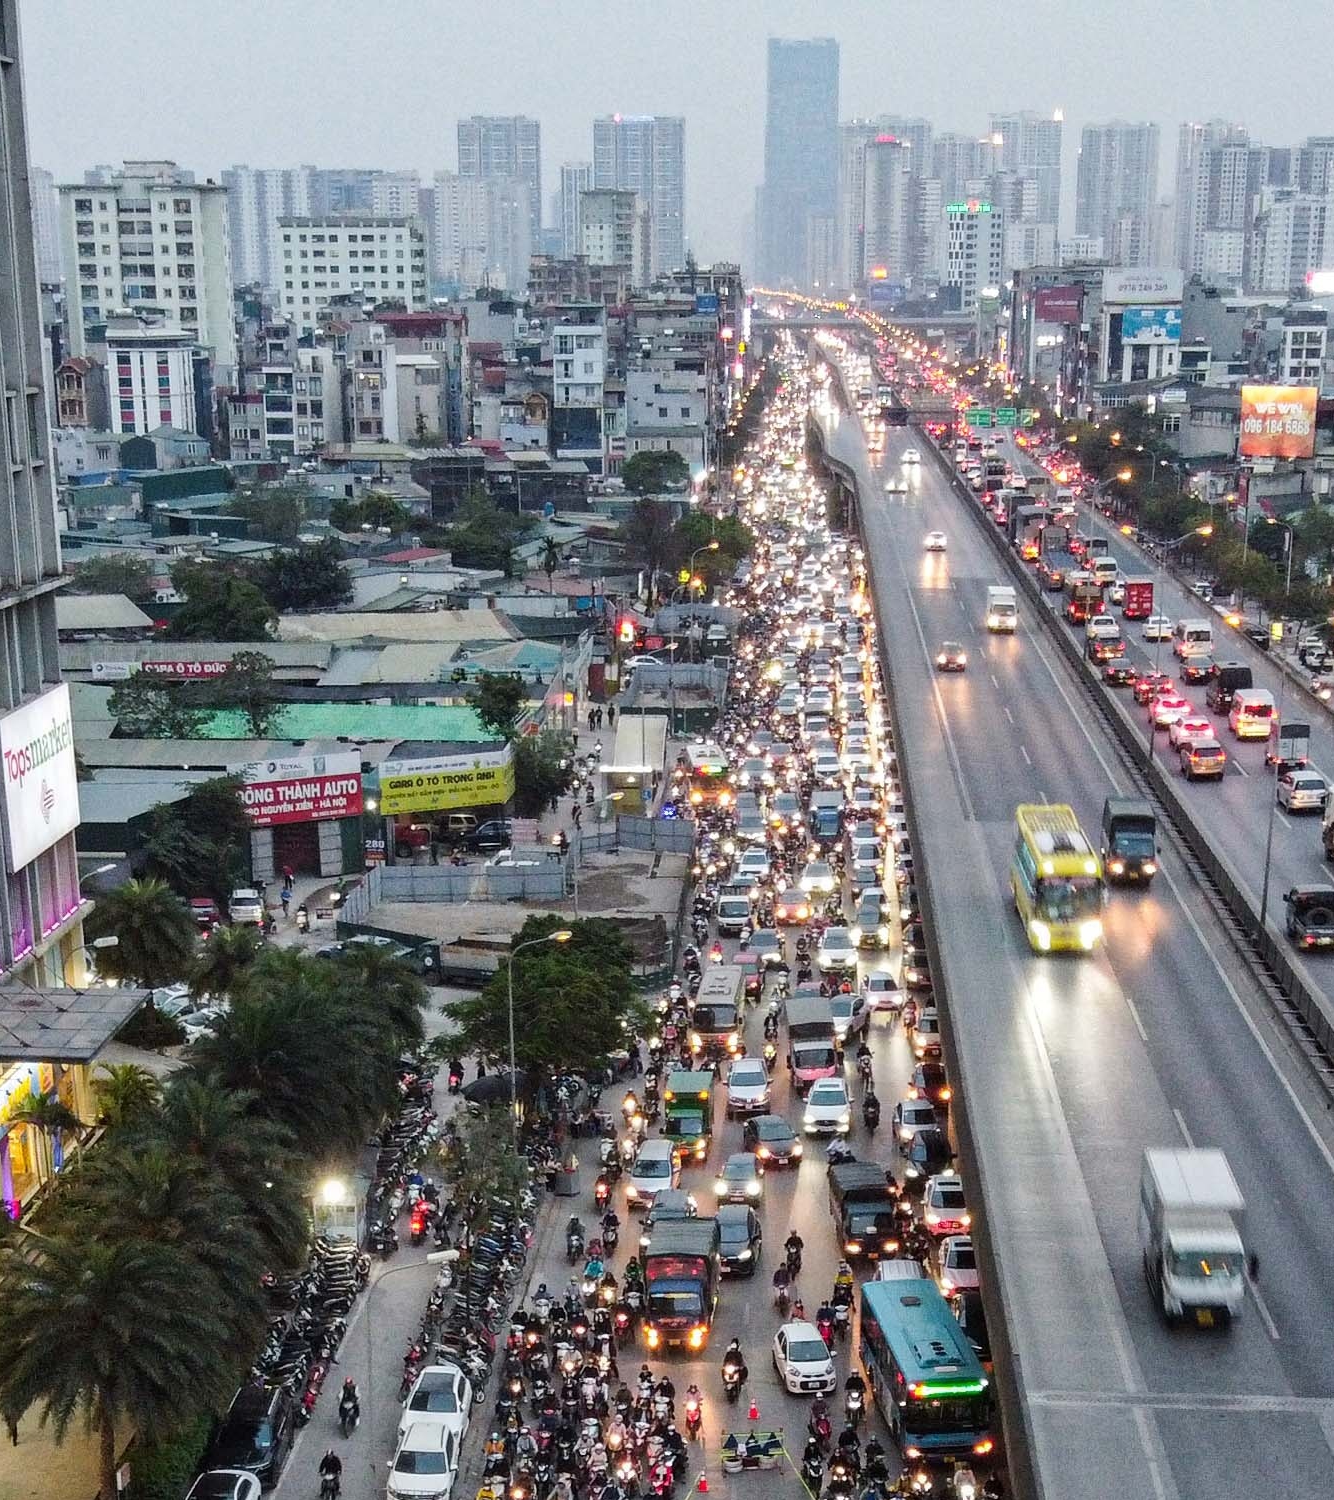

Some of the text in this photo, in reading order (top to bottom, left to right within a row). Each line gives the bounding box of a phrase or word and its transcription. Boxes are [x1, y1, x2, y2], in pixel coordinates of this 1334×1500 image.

[1255, 402, 1276, 415] WE
[1244, 418, 1263, 433] 096
[1266, 418, 1283, 434] 184
[176, 662, 185, 673] Ô
[187, 662, 201, 673] TÔ
[4, 717, 72, 788] Topsmarket
[277, 781, 321, 801] THÀNH
[324, 779, 358, 796] AUTO
[365, 840, 385, 849] 280
